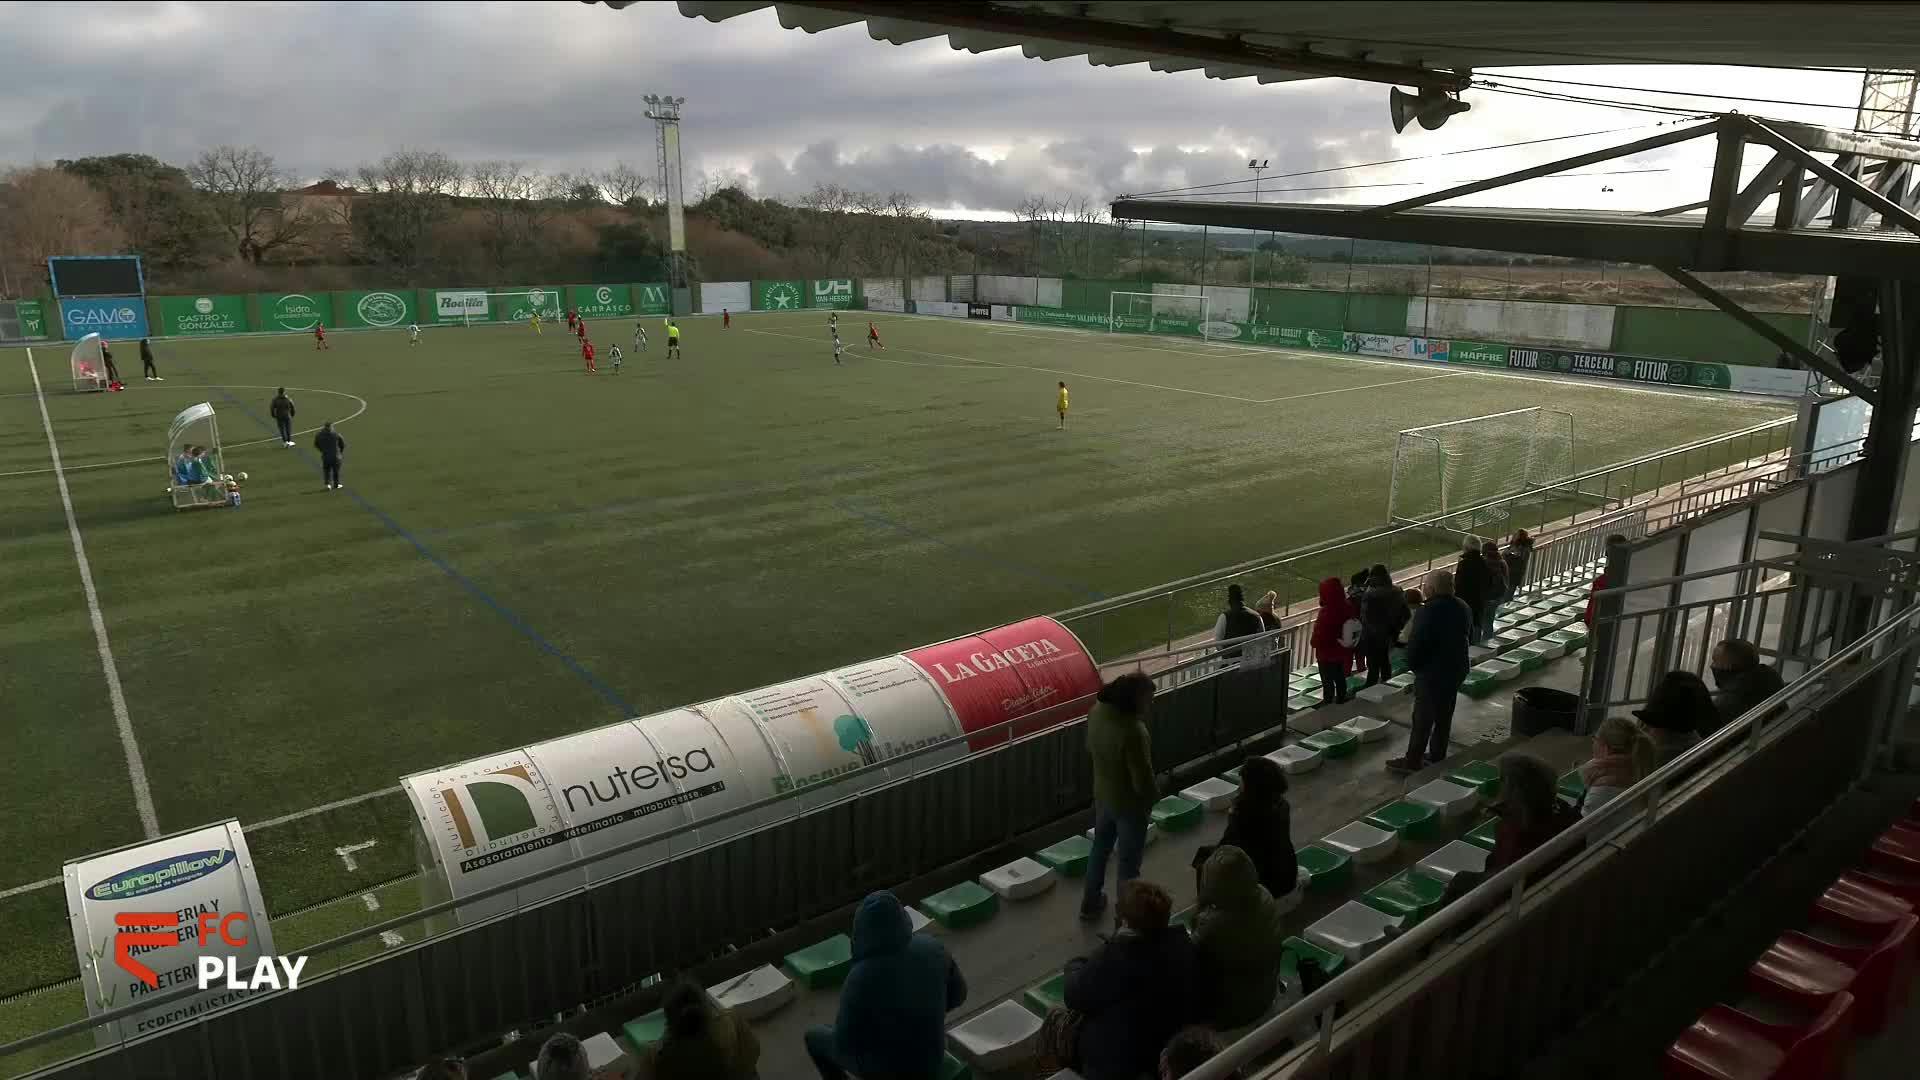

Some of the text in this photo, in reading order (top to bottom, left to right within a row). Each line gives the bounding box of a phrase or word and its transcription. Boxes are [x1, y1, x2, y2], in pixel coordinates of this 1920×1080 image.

[67, 308, 136, 325] GAMO
[578, 304, 631, 313] CARRASCO
[178, 313, 229, 322] CASTRO Y
[1460, 351, 1503, 361] MAPFRE
[1573, 354, 1614, 370] TERCERA
[933, 662, 977, 684] LA
[970, 638, 1061, 673] GACETA
[562, 747, 715, 812] nutersa
[464, 838, 553, 871] Asesoramiento
[563, 815, 624, 838] veterinario
[93, 848, 225, 897] Europillow
[211, 899, 219, 912] Y
